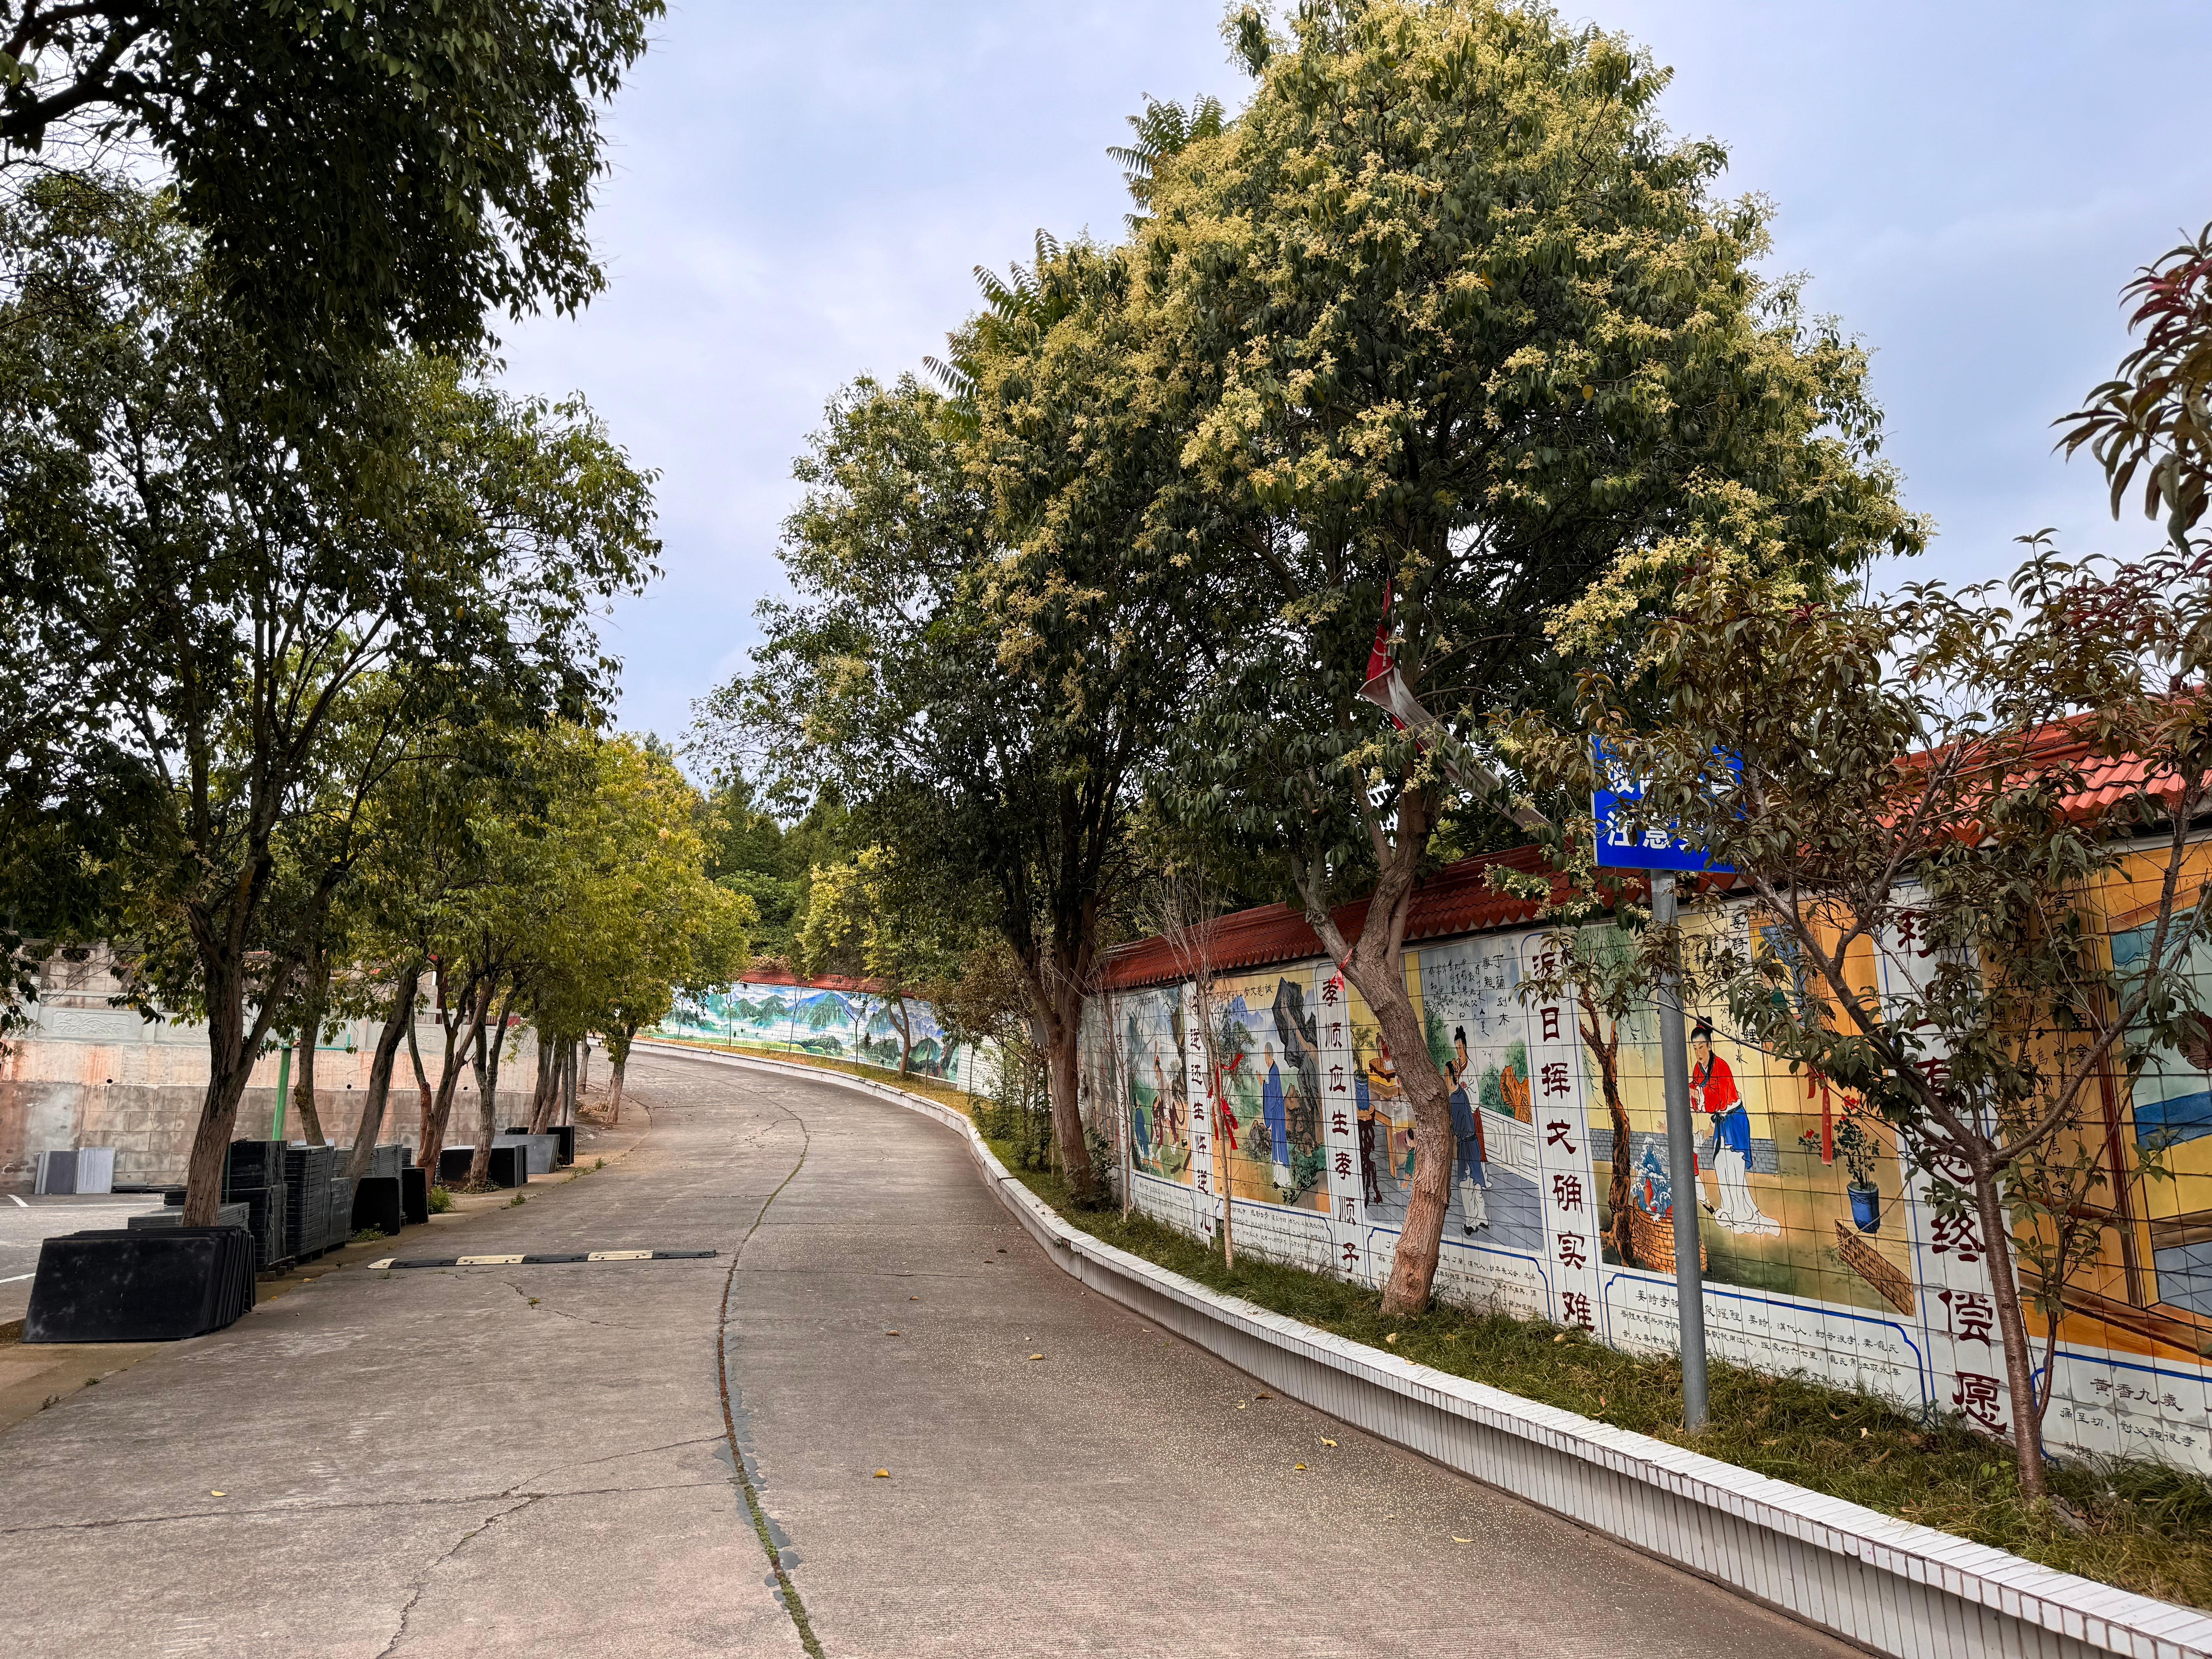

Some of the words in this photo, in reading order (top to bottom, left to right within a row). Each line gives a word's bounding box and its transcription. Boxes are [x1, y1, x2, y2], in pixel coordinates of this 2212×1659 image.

[1322, 978, 1360, 1273] 孝顺应生孝顺子
